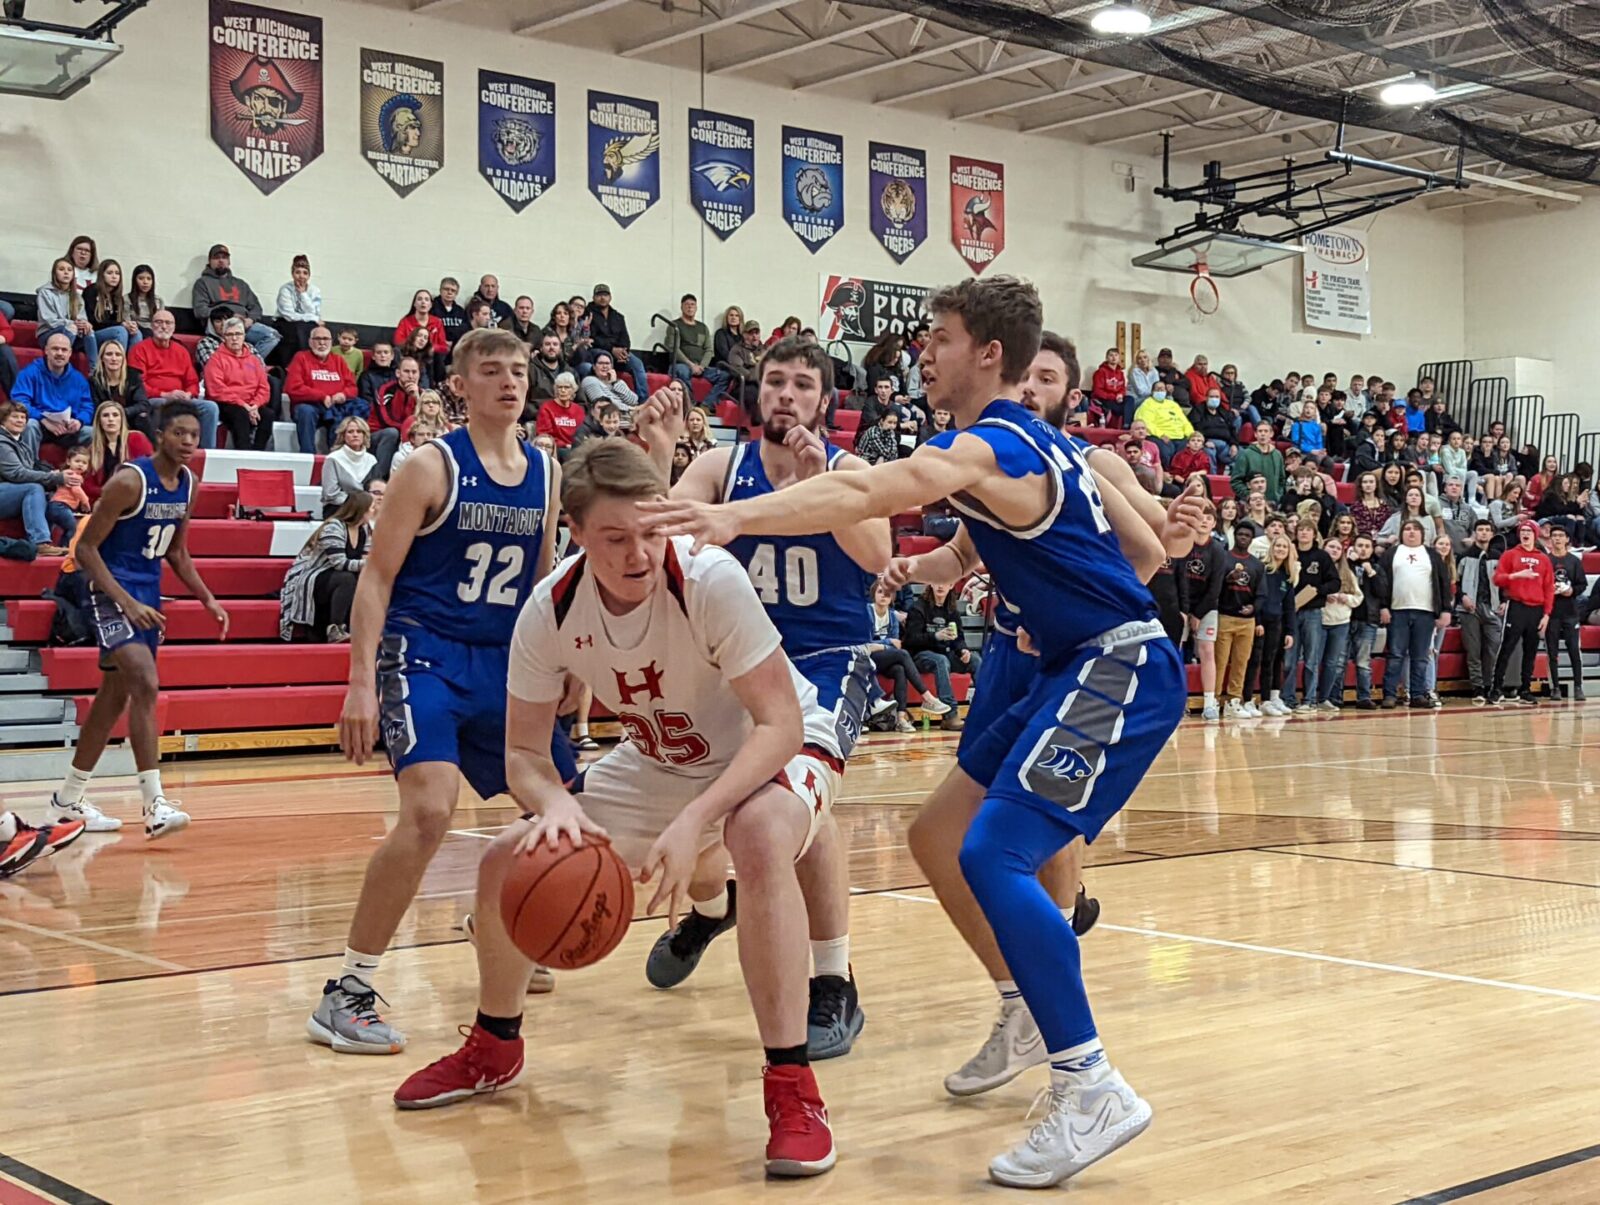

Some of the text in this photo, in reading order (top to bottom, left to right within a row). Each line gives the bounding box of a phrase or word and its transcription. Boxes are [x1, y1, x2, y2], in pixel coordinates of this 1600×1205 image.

[223, 16, 310, 41] WEST MICHIGAN
[213, 26, 319, 60] CONFERENCE
[371, 62, 434, 80] WEST MICHIGAN
[363, 69, 441, 95] CONFERENCE
[488, 83, 547, 100] WEST MICHIGAN
[481, 90, 554, 114] CONFERENCE
[596, 103, 651, 119] WEST MICHIGAN
[590, 109, 657, 133] CONFERENCE
[698, 120, 747, 136] WEST MICHIGAN
[247, 137, 289, 152] HART
[691, 127, 752, 149] CONFERENCE
[790, 137, 836, 151] WEST MICHIGAN
[234, 147, 301, 179] PIRATES
[784, 144, 841, 164] CONFERENCE
[876, 152, 920, 165] WEST MICHIGAN
[376, 161, 429, 187] SPARTANS
[487, 167, 548, 184] MONTAGUE
[871, 160, 924, 178] CONFERENCE
[957, 166, 998, 179] WEST MICHIGAN
[492, 176, 542, 202] WILDCATS
[952, 172, 1002, 191] CONFERENCE
[602, 194, 647, 217] NORSEMEN
[706, 209, 741, 232] EAGLES
[793, 222, 833, 242] BULLDOGS
[1304, 232, 1359, 252] HOMETOWN
[883, 234, 914, 255] TIGERS
[961, 245, 994, 263] VIKINGS
[874, 284, 894, 292] HART
[141, 524, 176, 560] 30
[456, 542, 524, 606] 32
[752, 543, 819, 607] 40
[611, 660, 664, 706] H
